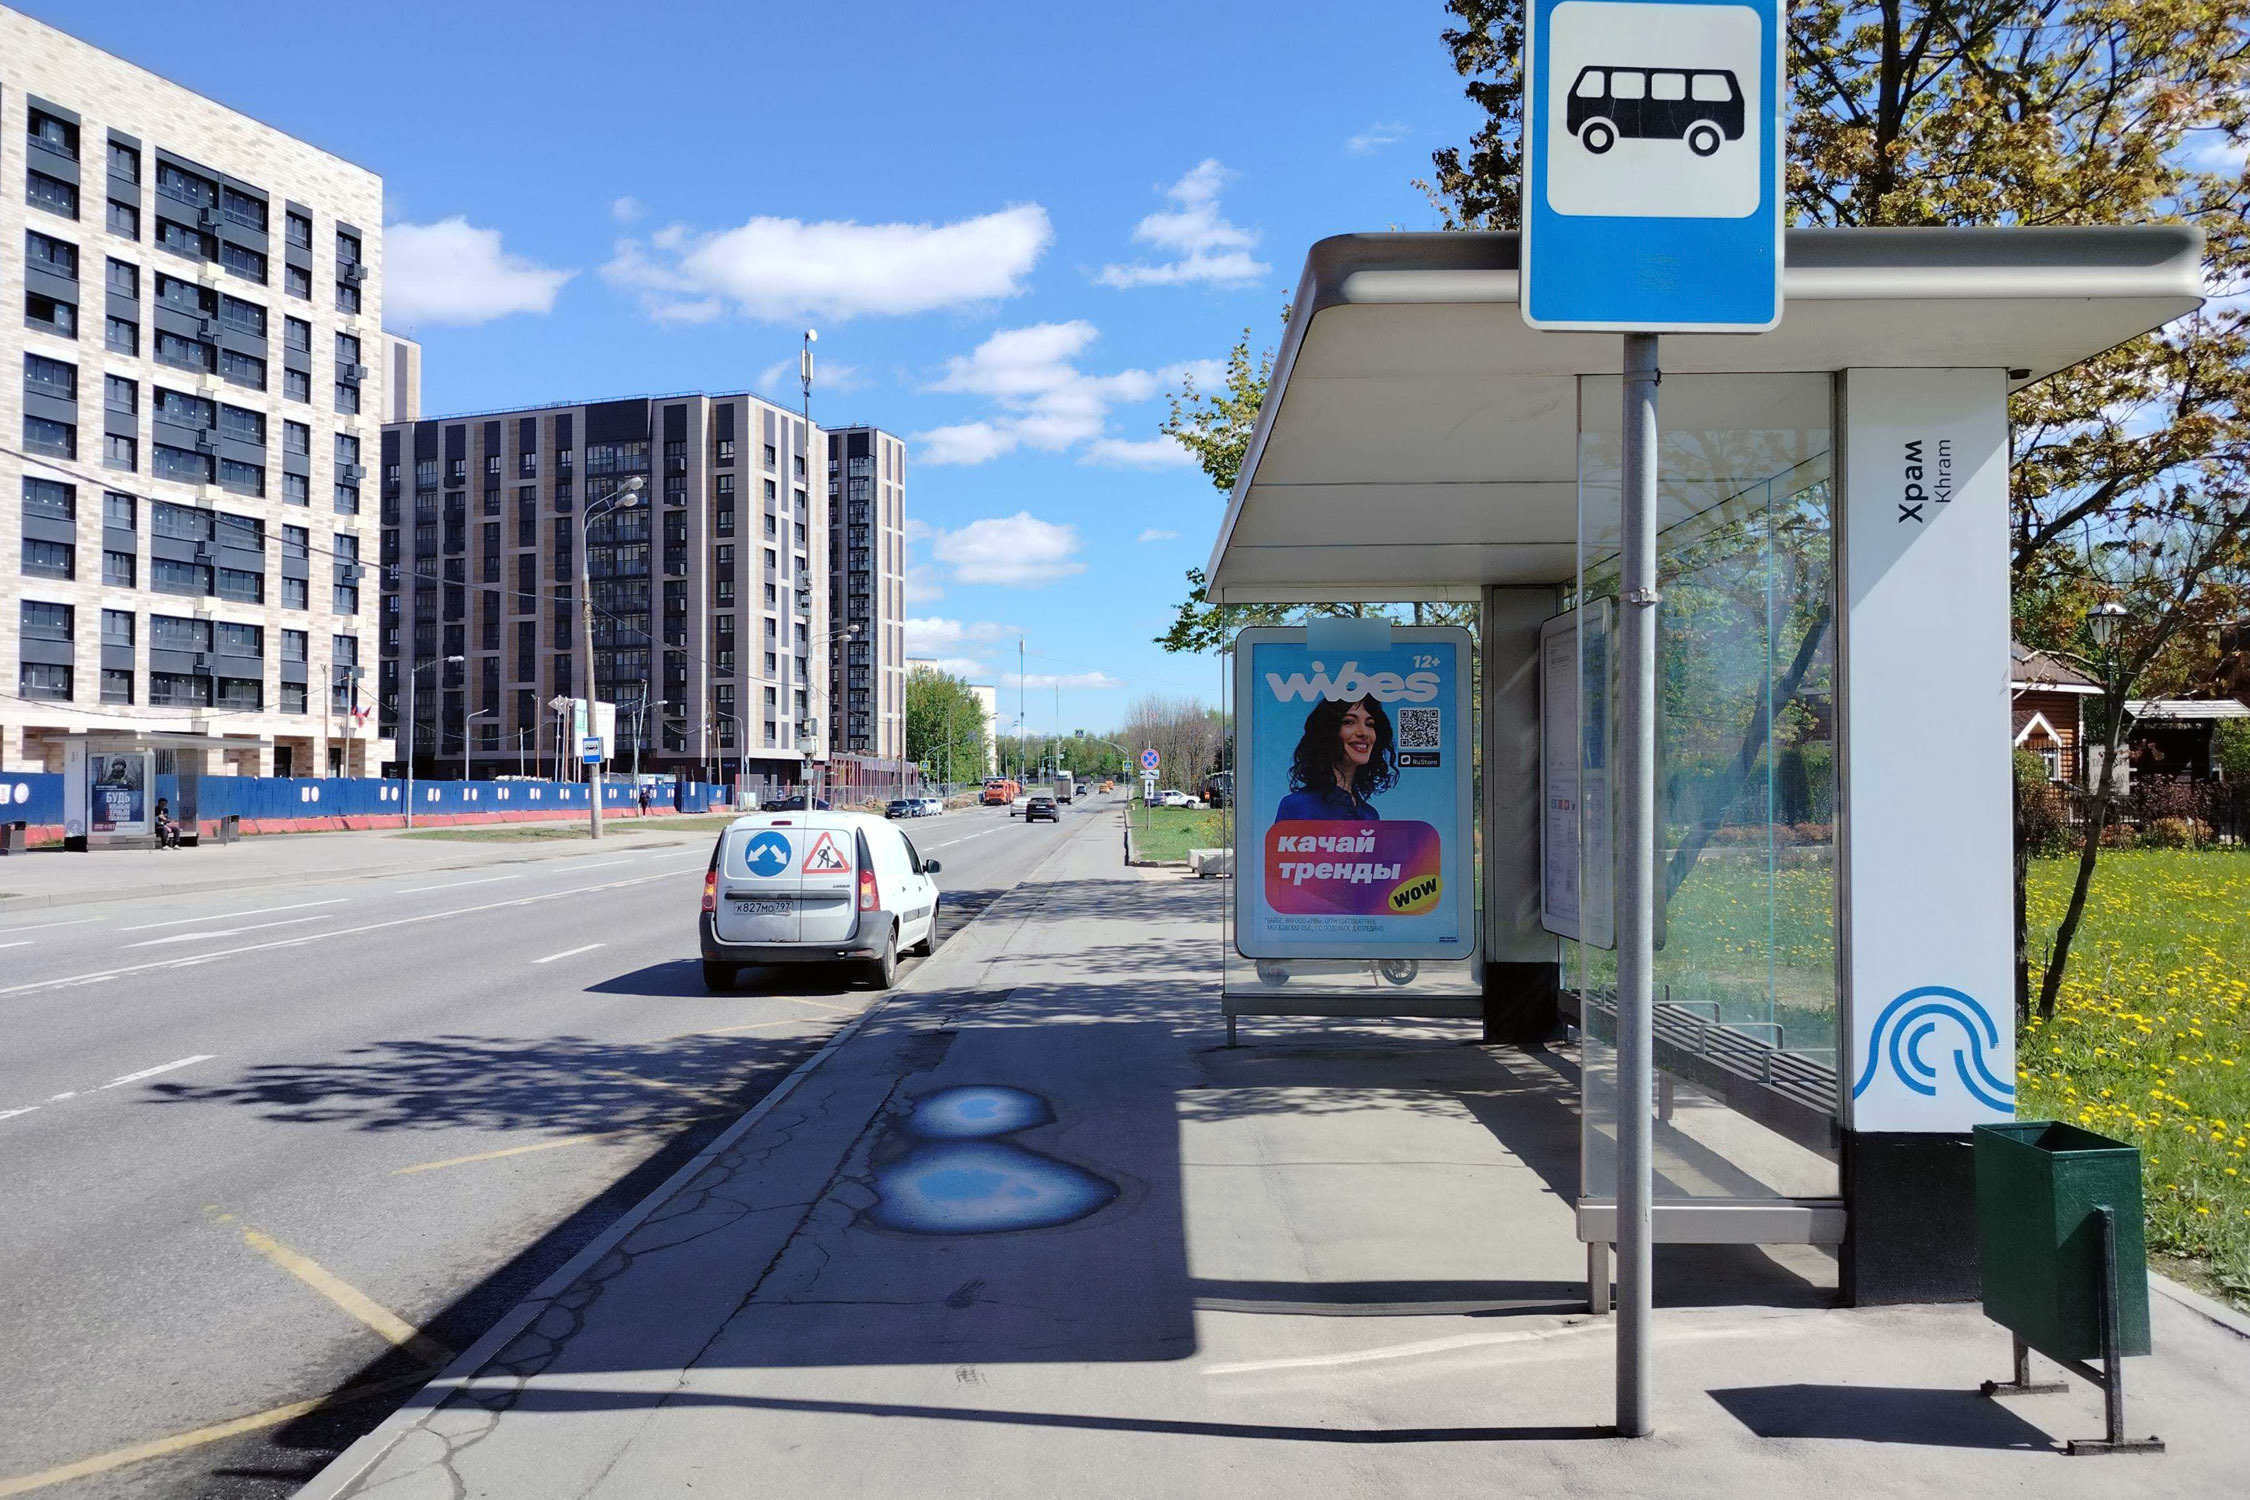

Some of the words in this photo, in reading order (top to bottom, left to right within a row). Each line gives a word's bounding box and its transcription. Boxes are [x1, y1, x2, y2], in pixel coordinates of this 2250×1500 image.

[1898, 439, 1929, 524] Храм
[1934, 439, 1951, 503] Khram
[1413, 655, 1440, 669] 12+
[1265, 660, 1441, 702] wibes
[106, 792, 130, 803] БУДЬ
[1277, 829, 1376, 853] качай
[1277, 861, 1401, 886] тренды
